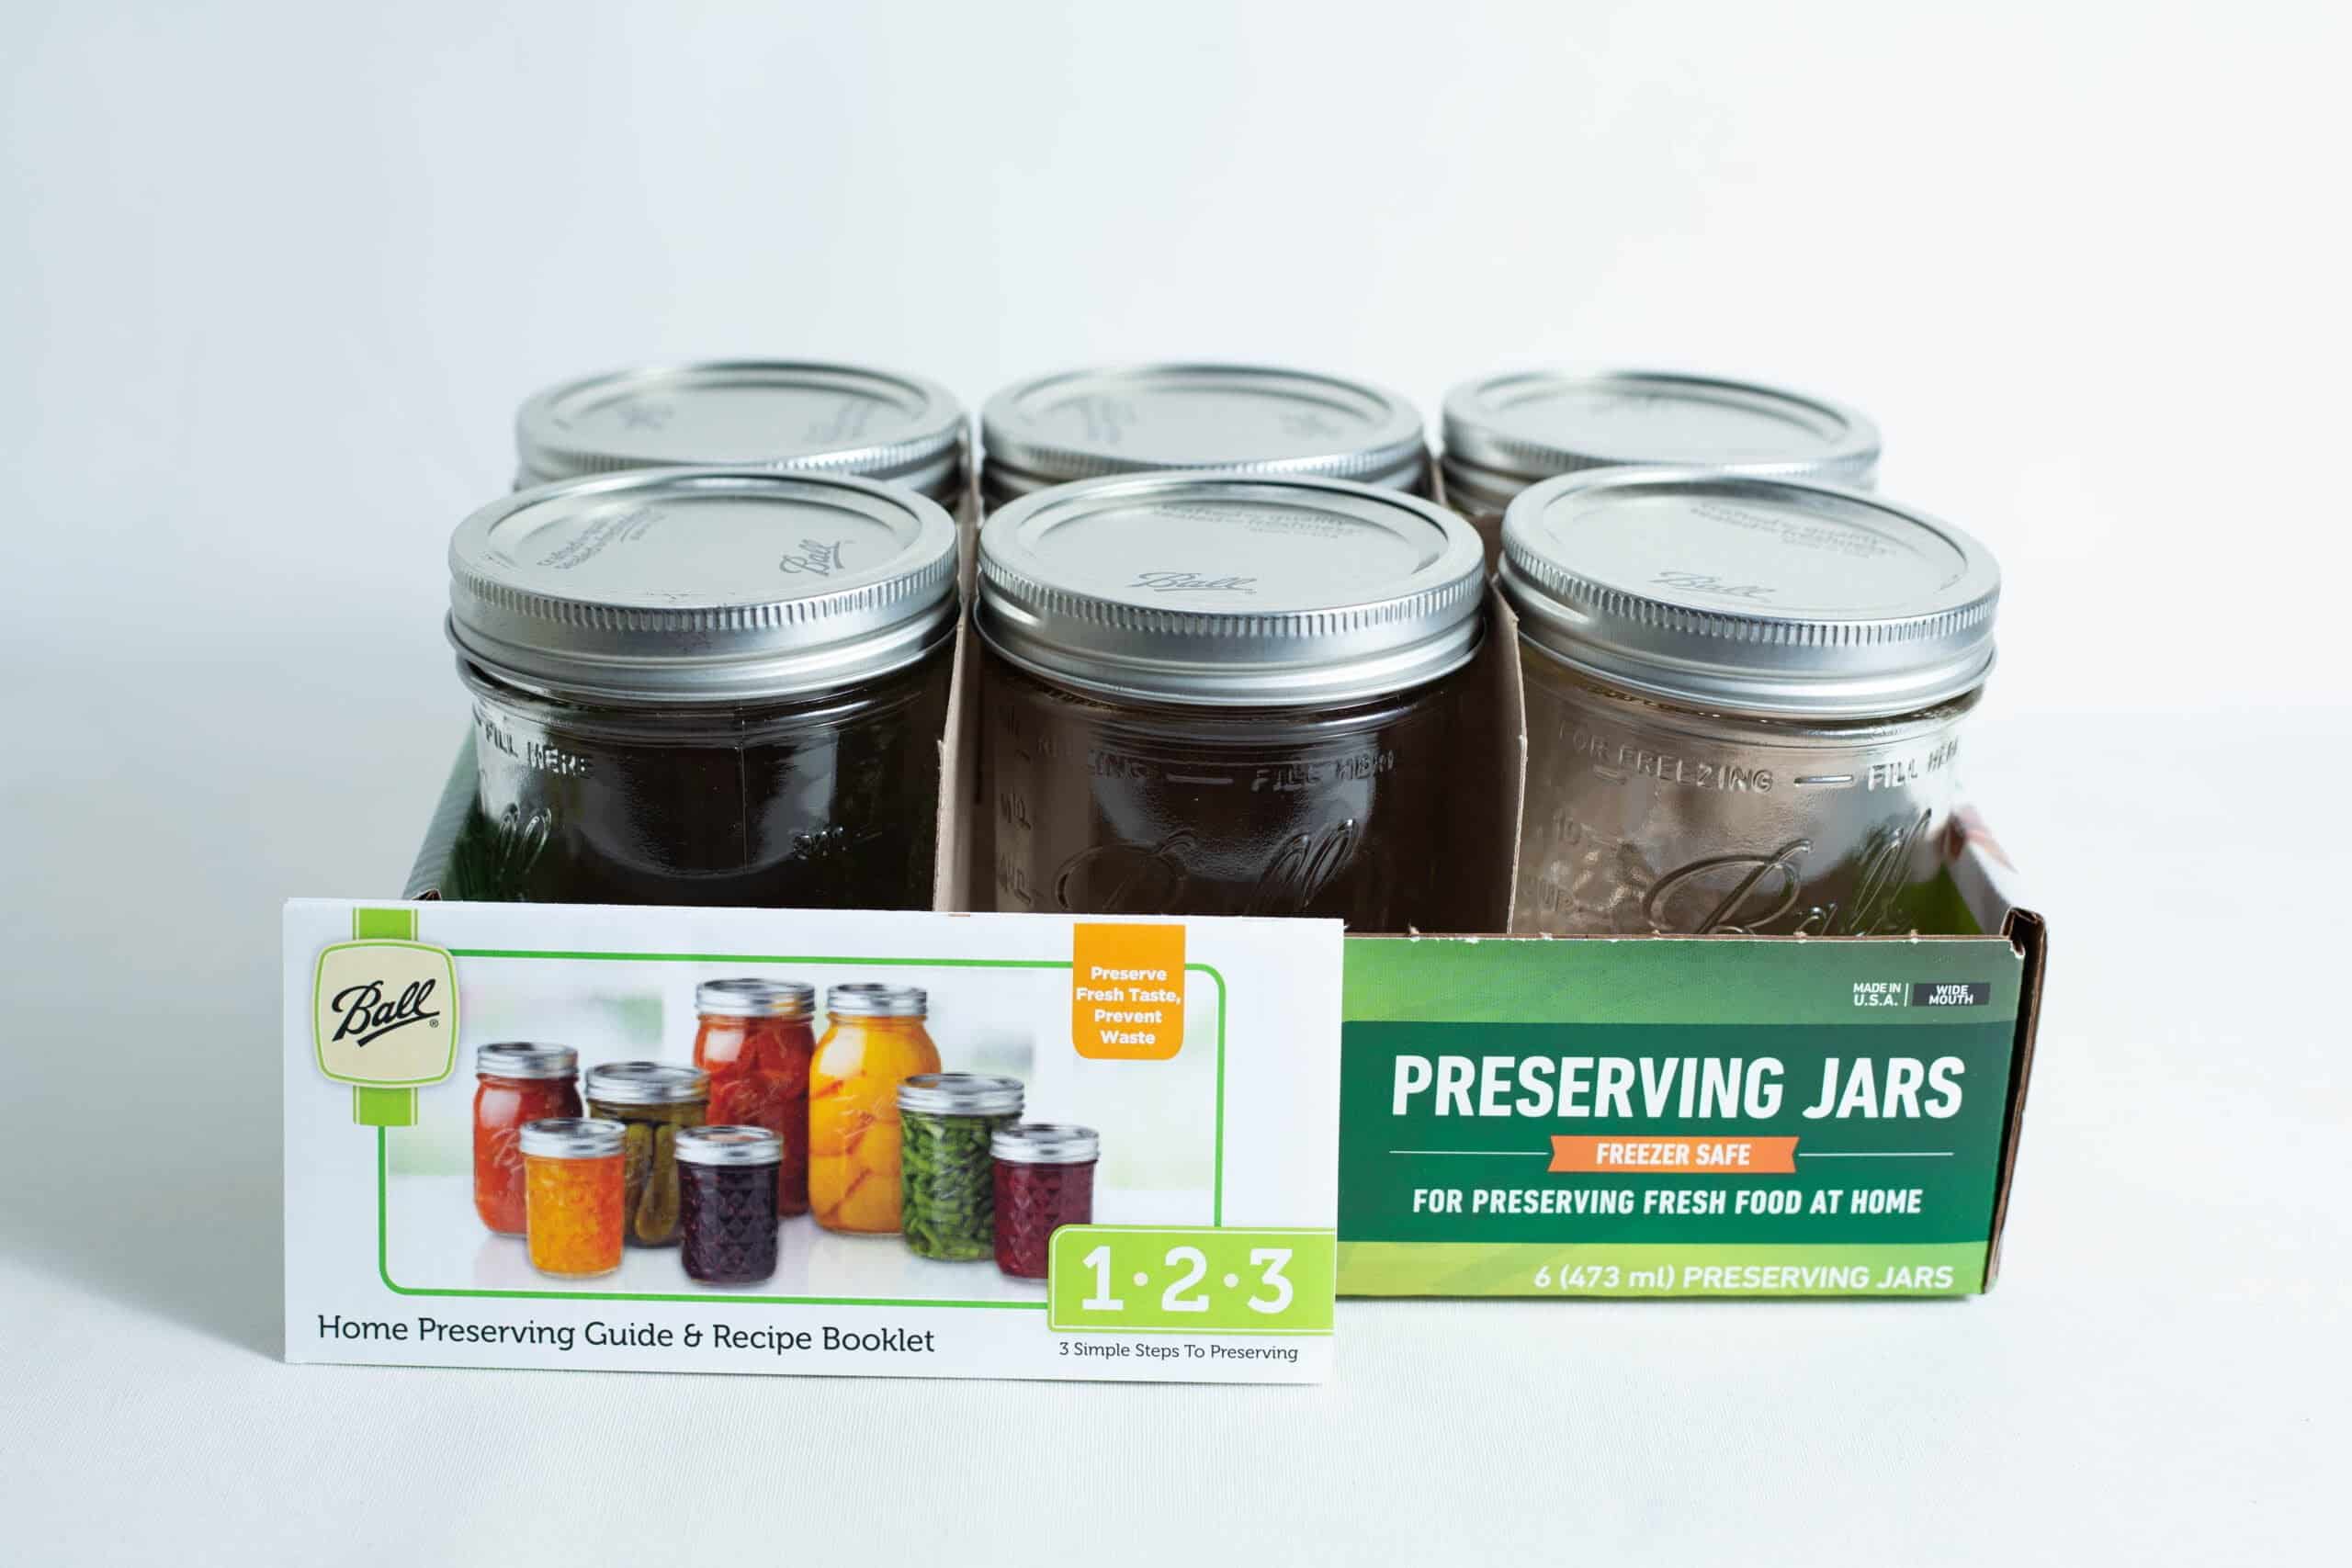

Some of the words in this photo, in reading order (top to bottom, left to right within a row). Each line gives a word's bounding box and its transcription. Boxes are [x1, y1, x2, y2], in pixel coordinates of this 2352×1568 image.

[779, 538, 845, 577] Ball
[1130, 571, 1258, 593] Ball
[1867, 759, 1918, 792] FILL
[1091, 966, 1167, 981] Preserve
[1077, 987, 1124, 1001] Fresh
[1129, 988, 1181, 1004] Taste,
[1853, 983, 1887, 993] MADE
[1889, 983, 1902, 993] IN
[1936, 985, 1969, 995] WIDE
[1854, 994, 1898, 1006] U.S.A.
[1929, 994, 1973, 1004] MOUTH
[332, 979, 439, 1047] Ball
[1095, 1010, 1162, 1023] Prevent
[1101, 1031, 1155, 1043] Waste
[1393, 1055, 1784, 1119] PRESERVING
[1803, 1056, 1964, 1119] JARS
[1597, 1144, 1690, 1165] FREEZER
[1696, 1144, 1751, 1165] SAFE
[1413, 1189, 1463, 1213] FOR
[1473, 1190, 1634, 1214] PRESERVING
[1644, 1190, 1725, 1214] FRESH
[1736, 1190, 1802, 1214] FOOD
[1810, 1190, 1843, 1213] AT
[1851, 1189, 1923, 1213] HOME
[1534, 1266, 1551, 1288] 6
[1560, 1264, 1619, 1290] (473
[1630, 1264, 1674, 1290] ml)
[1683, 1266, 1869, 1289] PRESERVING
[1876, 1266, 1953, 1289] JARS
[318, 1315, 408, 1340] Home
[419, 1318, 575, 1350] Preserving
[585, 1322, 673, 1347] Guide
[684, 1324, 703, 1347] &
[713, 1325, 811, 1355] Recipe
[823, 1327, 933, 1352] Booklet
[1060, 1342, 1069, 1355] 3
[1075, 1342, 1130, 1359] Simple
[1136, 1344, 1179, 1359] Steps
[1184, 1345, 1204, 1358] To
[1212, 1345, 1297, 1362] Preserving
